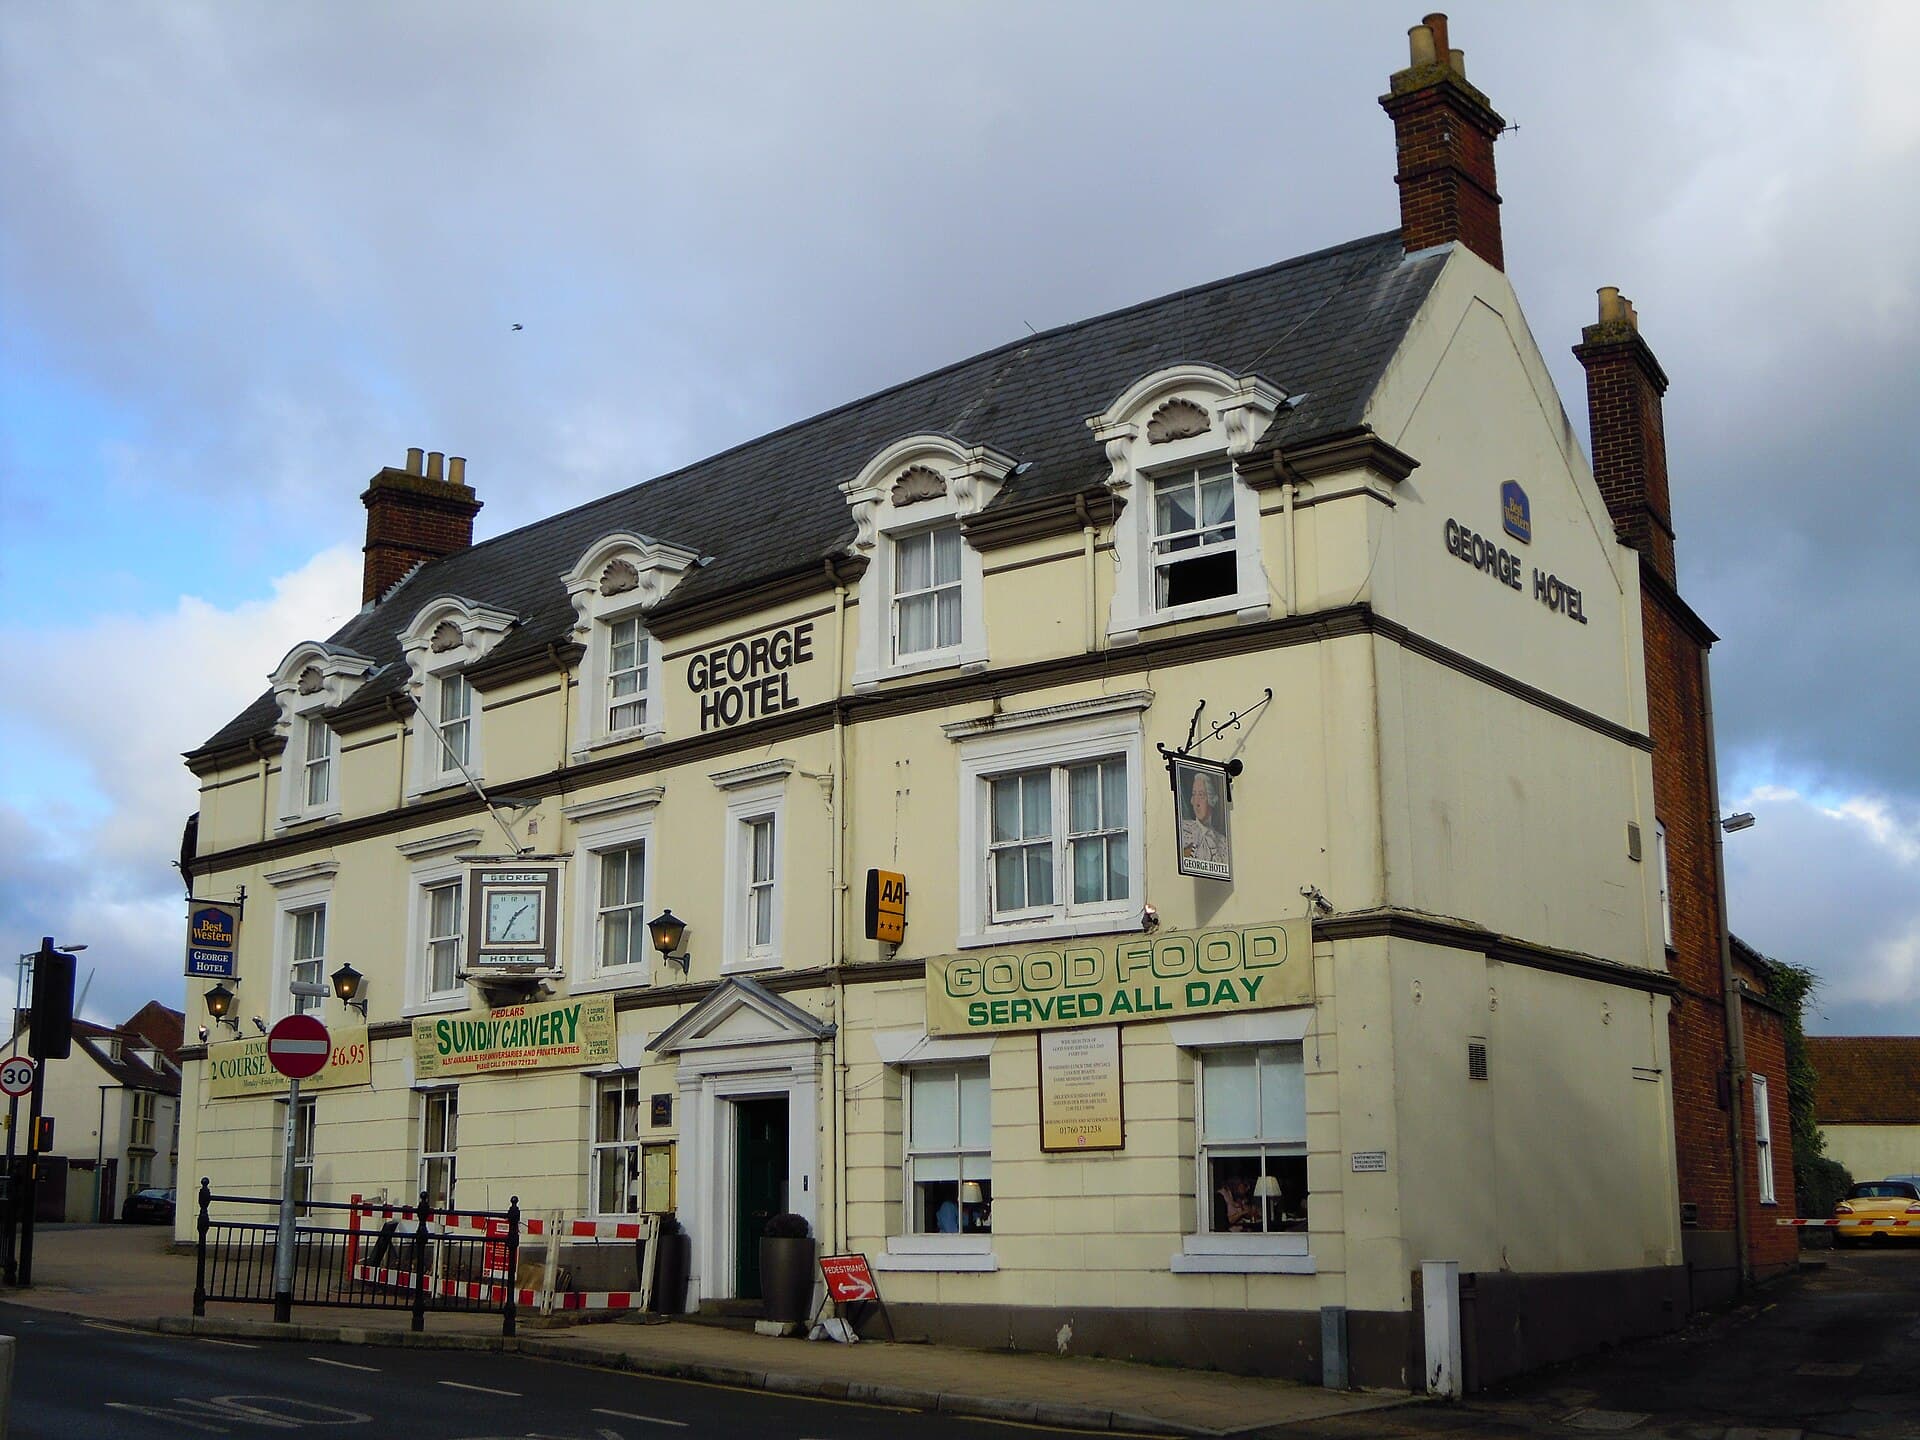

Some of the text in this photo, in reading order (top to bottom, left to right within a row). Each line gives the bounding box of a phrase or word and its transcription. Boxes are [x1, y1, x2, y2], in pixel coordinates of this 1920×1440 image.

[1509, 497, 1523, 517] Best
[1504, 506, 1530, 531] Western
[1445, 518, 1588, 625] GEORGE HOTEL
[687, 622, 814, 693] GEORGE
[700, 672, 799, 731] HOTEL
[1184, 859, 1229, 873] GEORGE HOTEL
[881, 880, 903, 904] AA
[202, 920, 223, 932] Best
[192, 927, 232, 943] Western
[194, 951, 229, 962] GEORGE
[945, 925, 1288, 998] GOOD FOOD
[196, 962, 225, 973] HOTEL
[967, 975, 1264, 1027] SERVED ALL DAY
[490, 1007, 525, 1019] PEDLARS
[436, 1003, 582, 1055] SUNDAY CARVERY
[245, 1041, 268, 1056] LUNC
[523, 1049, 536, 1057] AND
[536, 1047, 556, 1057] PRIVATE
[557, 1045, 580, 1055] PARTIES
[211, 1061, 217, 1081] 2
[220, 1055, 266, 1079] COURSE
[331, 1044, 365, 1067] £6.95
[3, 1068, 31, 1085] 30
[1060, 1125, 1102, 1135] 01760 721238
[824, 1263, 866, 1274] PEDESTRIANS
